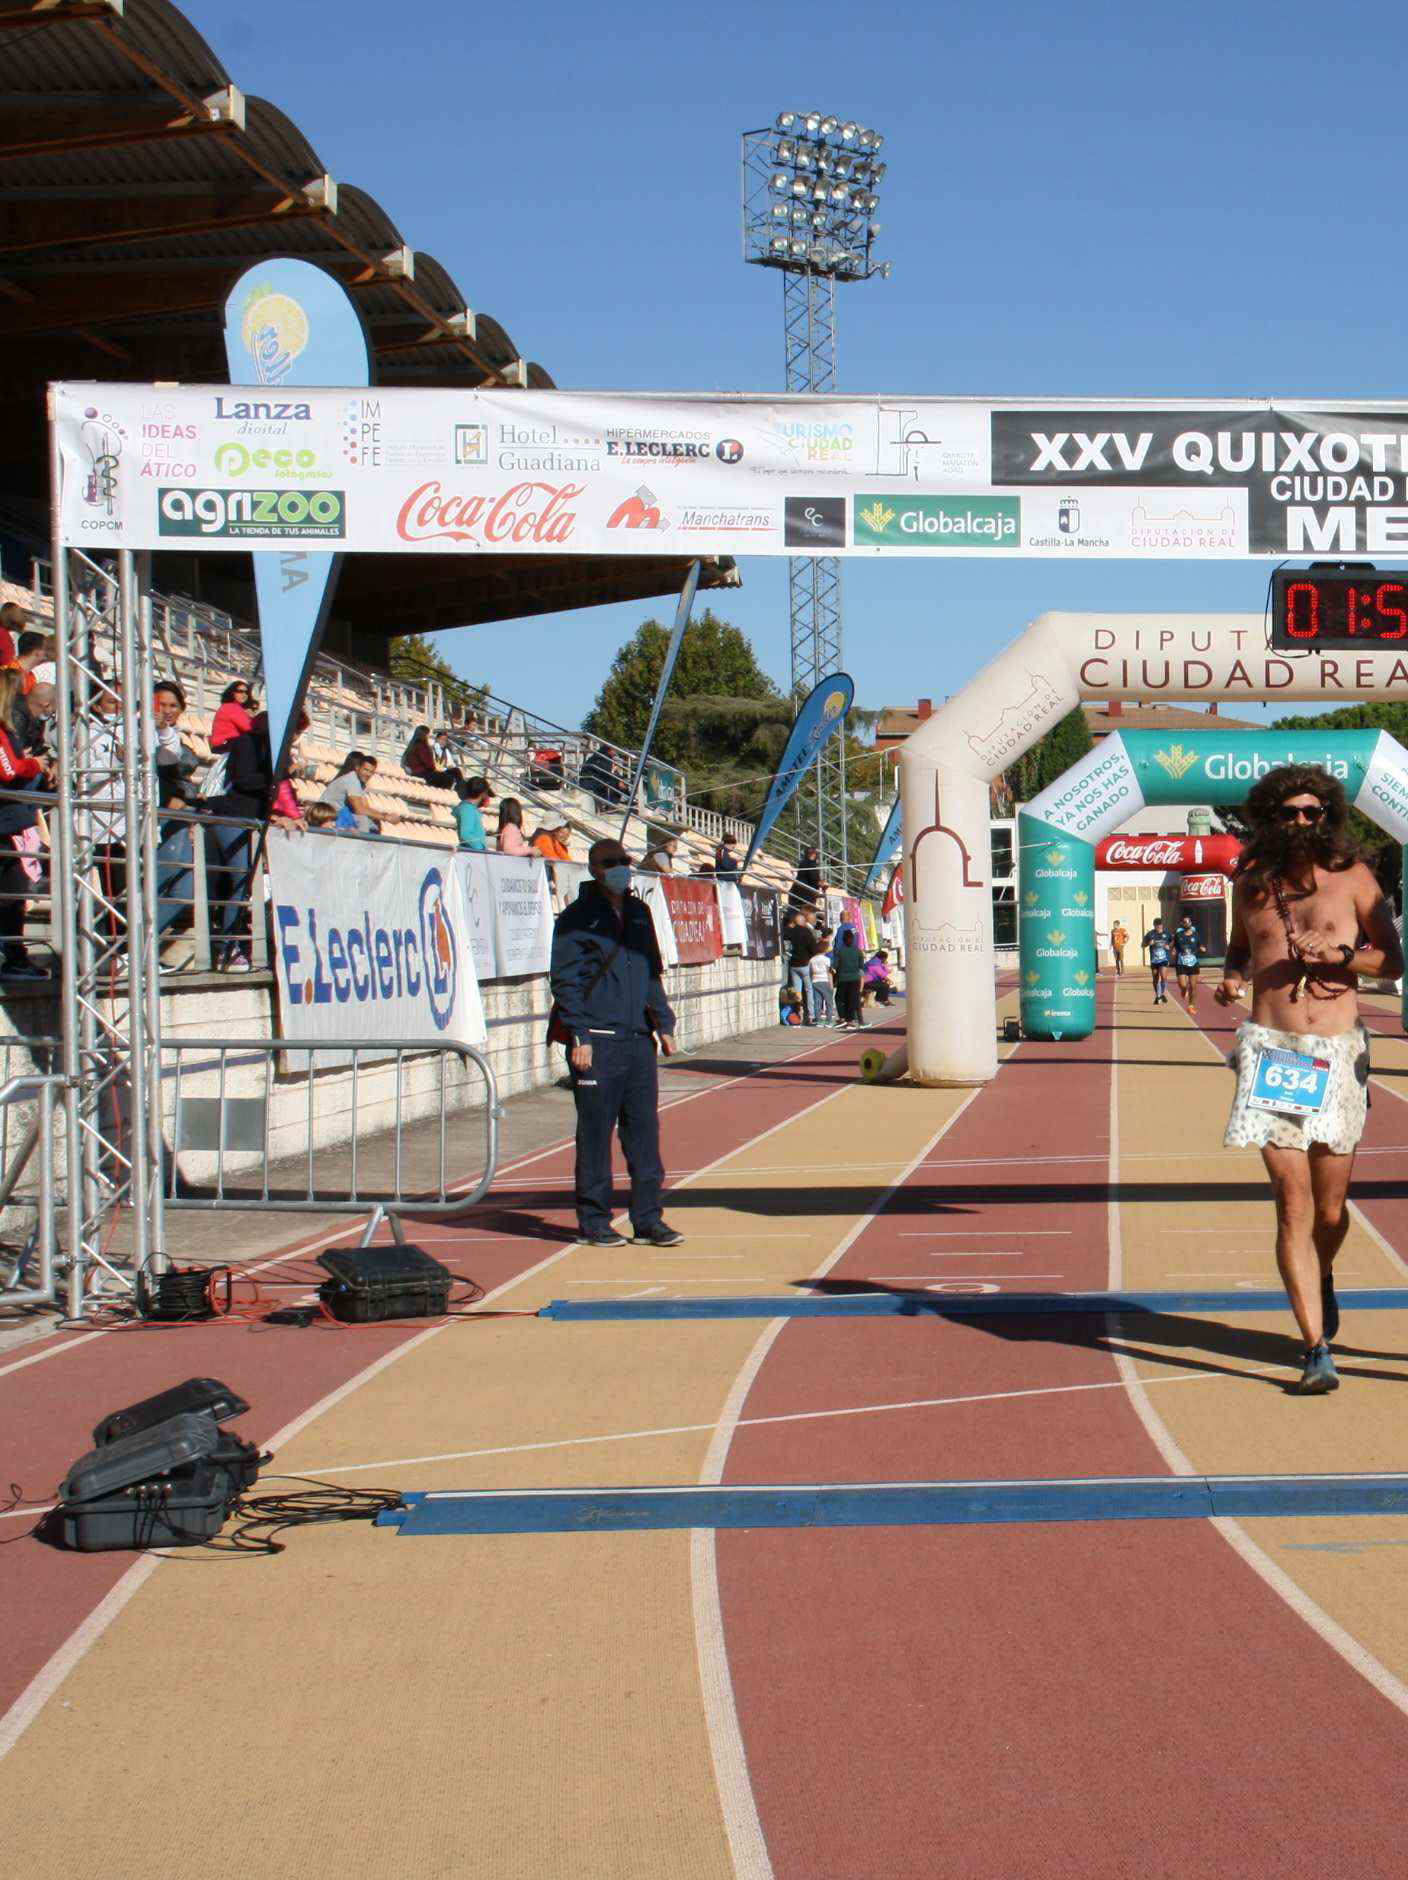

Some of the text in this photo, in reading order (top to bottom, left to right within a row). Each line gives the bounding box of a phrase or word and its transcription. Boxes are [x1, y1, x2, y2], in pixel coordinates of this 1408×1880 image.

[213, 397, 312, 420] Lanza
[361, 399, 381, 419] IM
[141, 424, 198, 439] IDEAS
[361, 423, 381, 442] PE
[498, 424, 557, 445] Hotel
[606, 428, 711, 441] HIPERMERCADOS
[361, 447, 381, 466] FE
[606, 441, 711, 458] E.LECLERC
[1029, 432, 1153, 471] XXV
[139, 458, 197, 477] ÁTICO
[498, 450, 601, 473] Guadiana
[1270, 477, 1397, 503] CIUDAD
[161, 490, 341, 532] agrizoo
[397, 480, 586, 544] Coca-Cola
[680, 511, 770, 527] Manchatrans
[80, 519, 124, 531] COPCM
[229, 526, 340, 536] LA TIENDA DE TUS ANIMALES
[900, 511, 1016, 540] Globalcaja
[1077, 536, 1110, 548] Mancha
[1131, 536, 1235, 548] CIUDAD REAL
[1079, 658, 1295, 690] CIUDAD
[986, 695, 1065, 767] CIUDAD REAL
[1042, 751, 1126, 820] A NOSOTROS,
[1055, 765, 1130, 828] YA NOS HAS
[1076, 784, 1130, 832] GANADO
[1105, 840, 1185, 865] Coca-Cola
[1035, 868, 1078, 880] Globalcaja
[276, 904, 421, 1007] E.Leclerc
[1036, 948, 1078, 960] Globalcaja
[1265, 1064, 1318, 1094] 634
